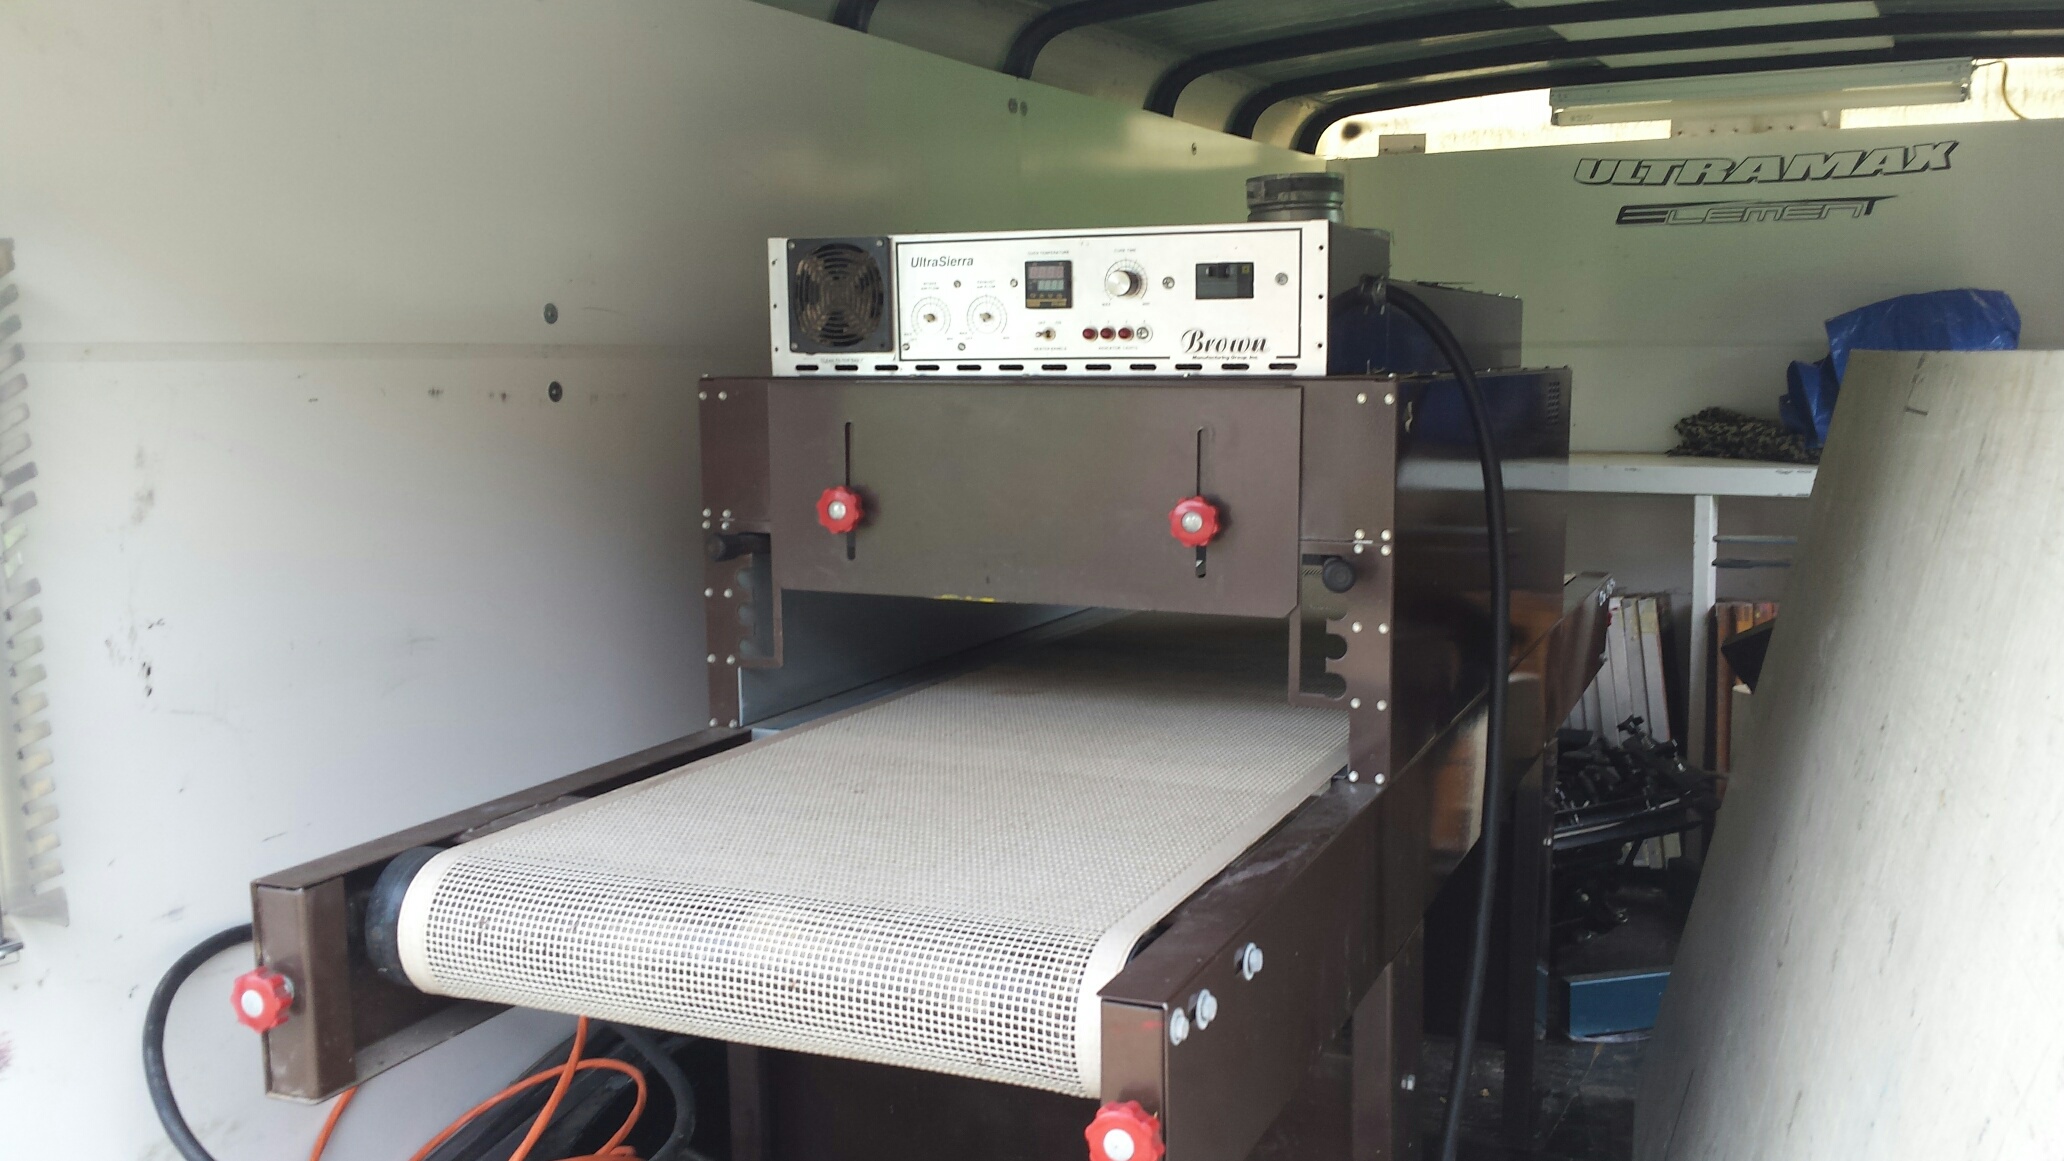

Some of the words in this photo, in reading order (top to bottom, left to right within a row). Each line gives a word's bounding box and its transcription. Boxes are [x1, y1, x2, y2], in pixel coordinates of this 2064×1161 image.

[1573, 140, 1959, 187] ULTRAMAX
[910, 255, 974, 268] UltraSierra
[1181, 328, 1270, 354] Brown
